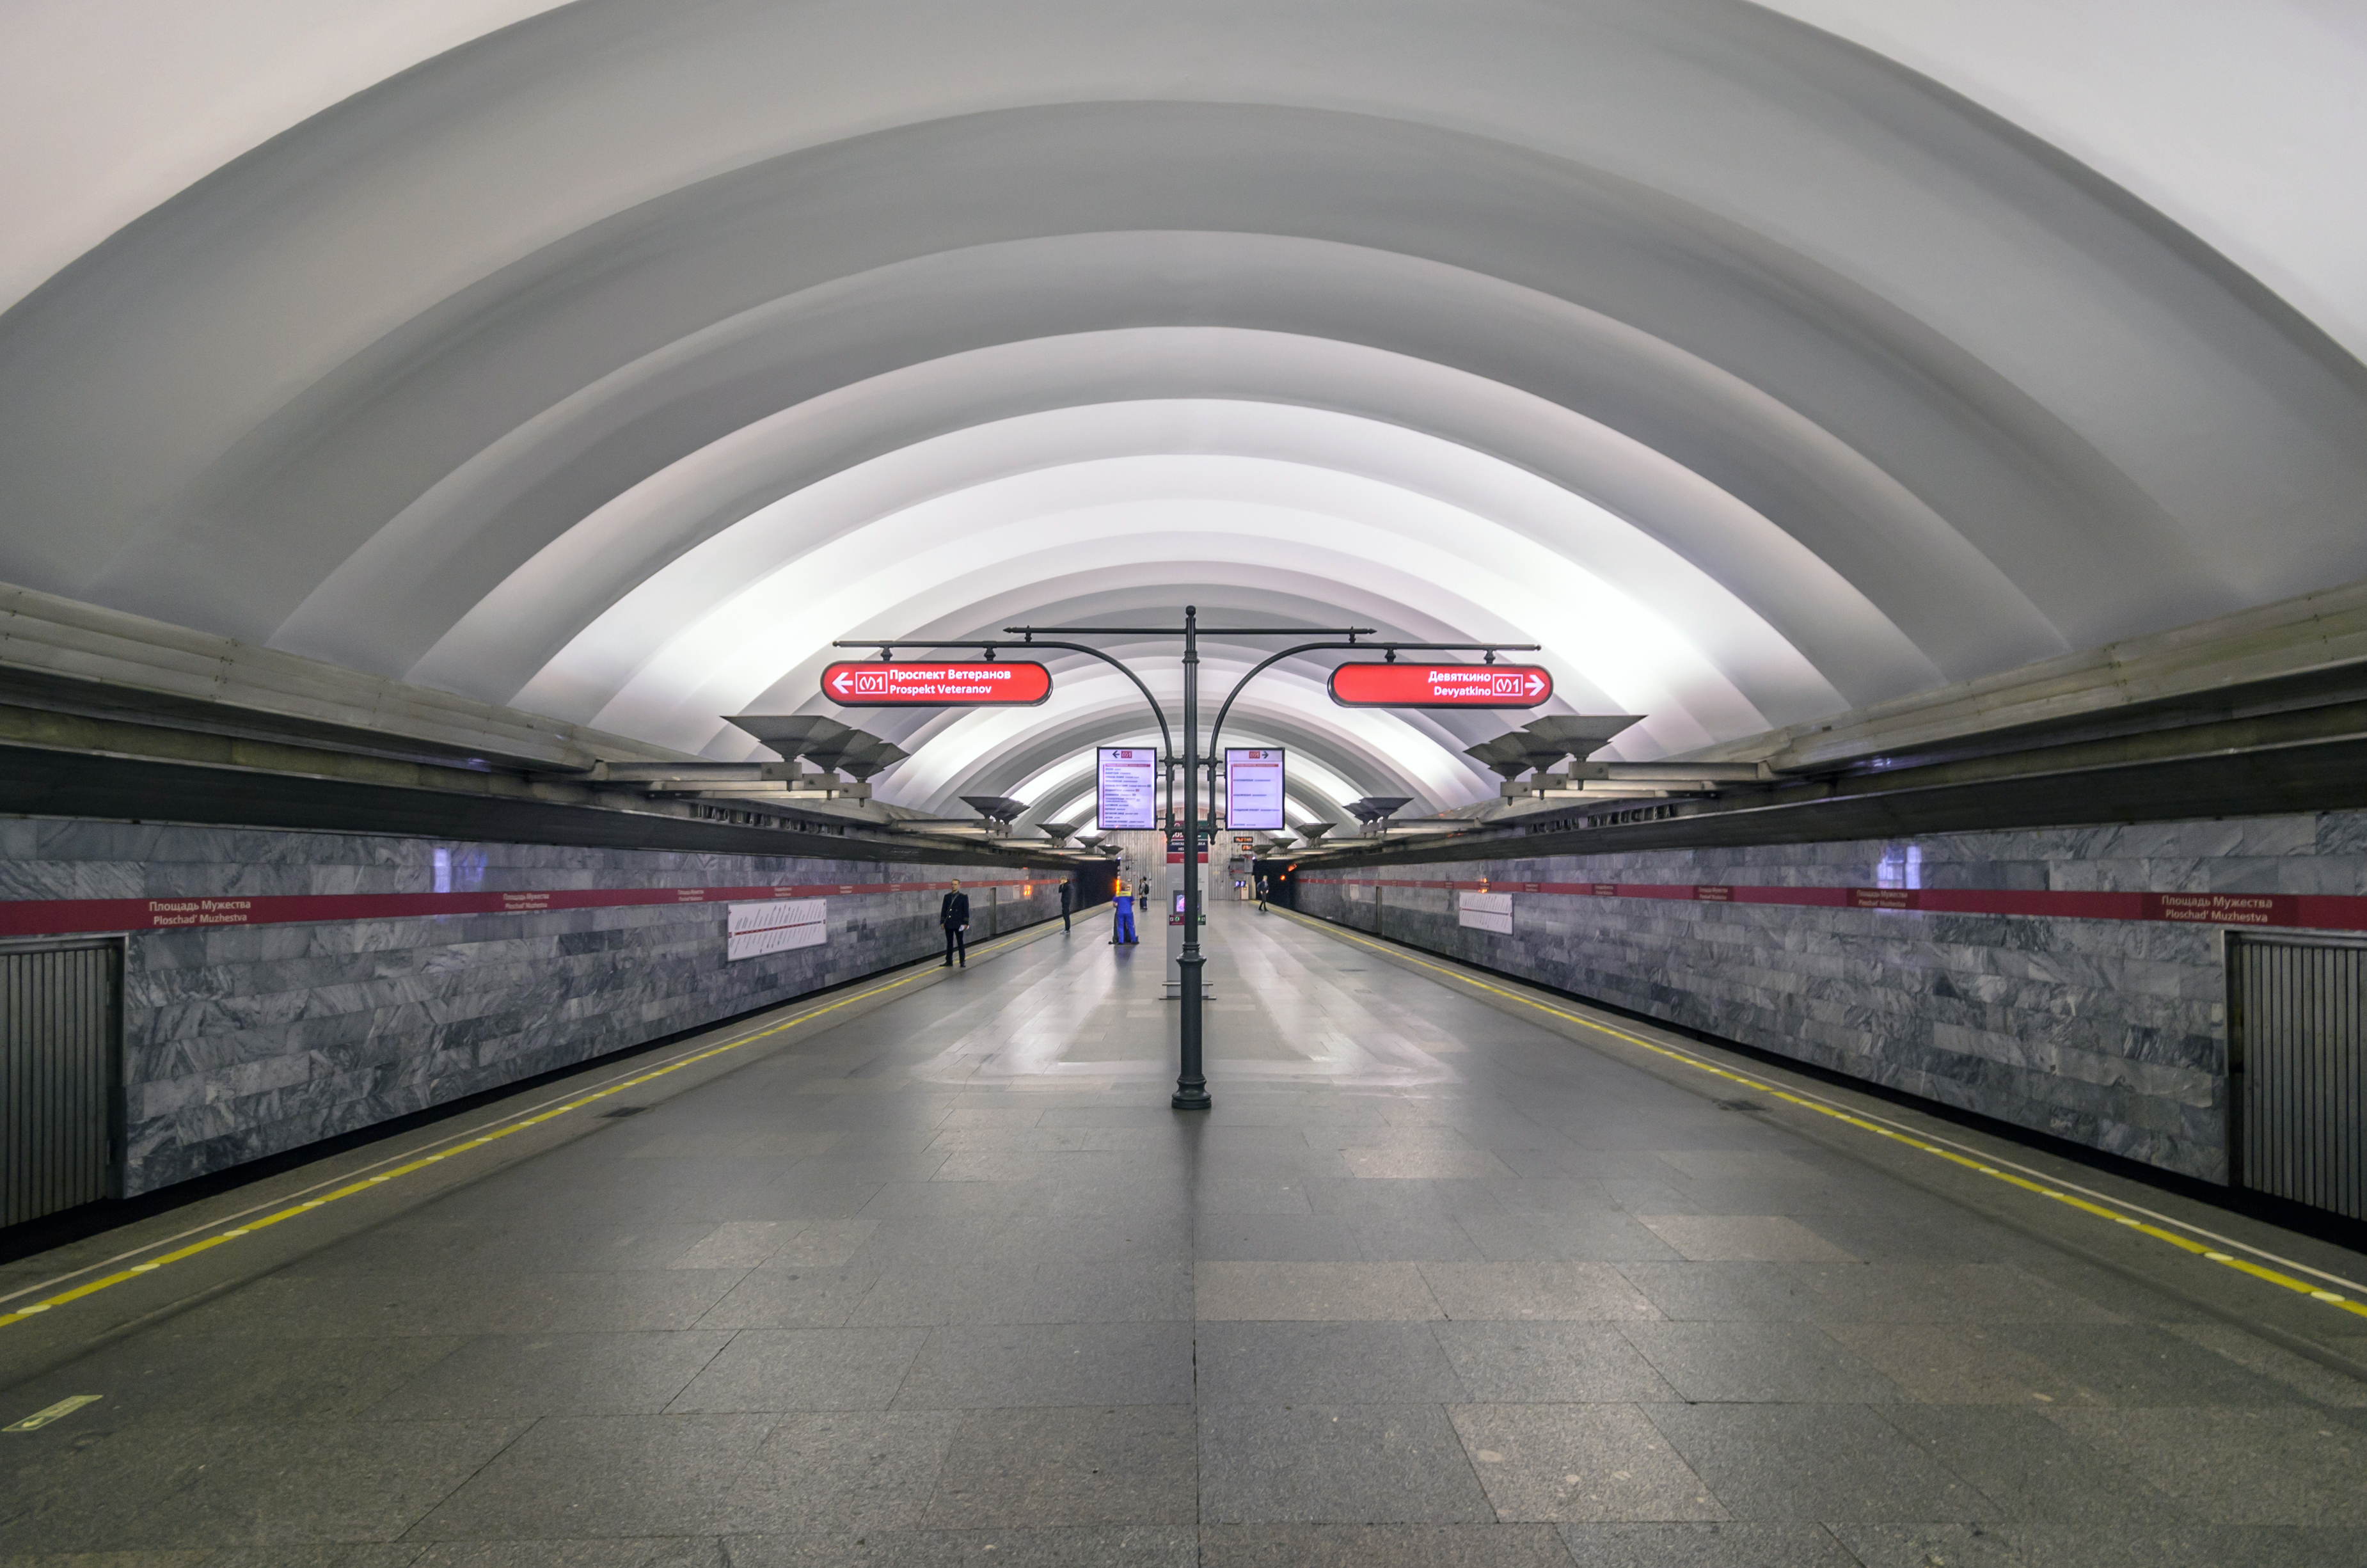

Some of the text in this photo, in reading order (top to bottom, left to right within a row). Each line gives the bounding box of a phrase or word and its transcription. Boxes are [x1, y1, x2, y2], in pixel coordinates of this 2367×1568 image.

[889, 669, 1011, 682] Проспект Ветеранов
[1428, 671, 1491, 683] Девяткино
[890, 685, 992, 695] Prospekt Veteranov
[1434, 686, 1491, 698] Devyatkino
[148, 900, 251, 912] Площадь Мужества
[2162, 896, 2273, 910] Площадь Мужества
[200, 913, 248, 923] Muzhestva
[2212, 910, 2268, 923] Muzhestva
